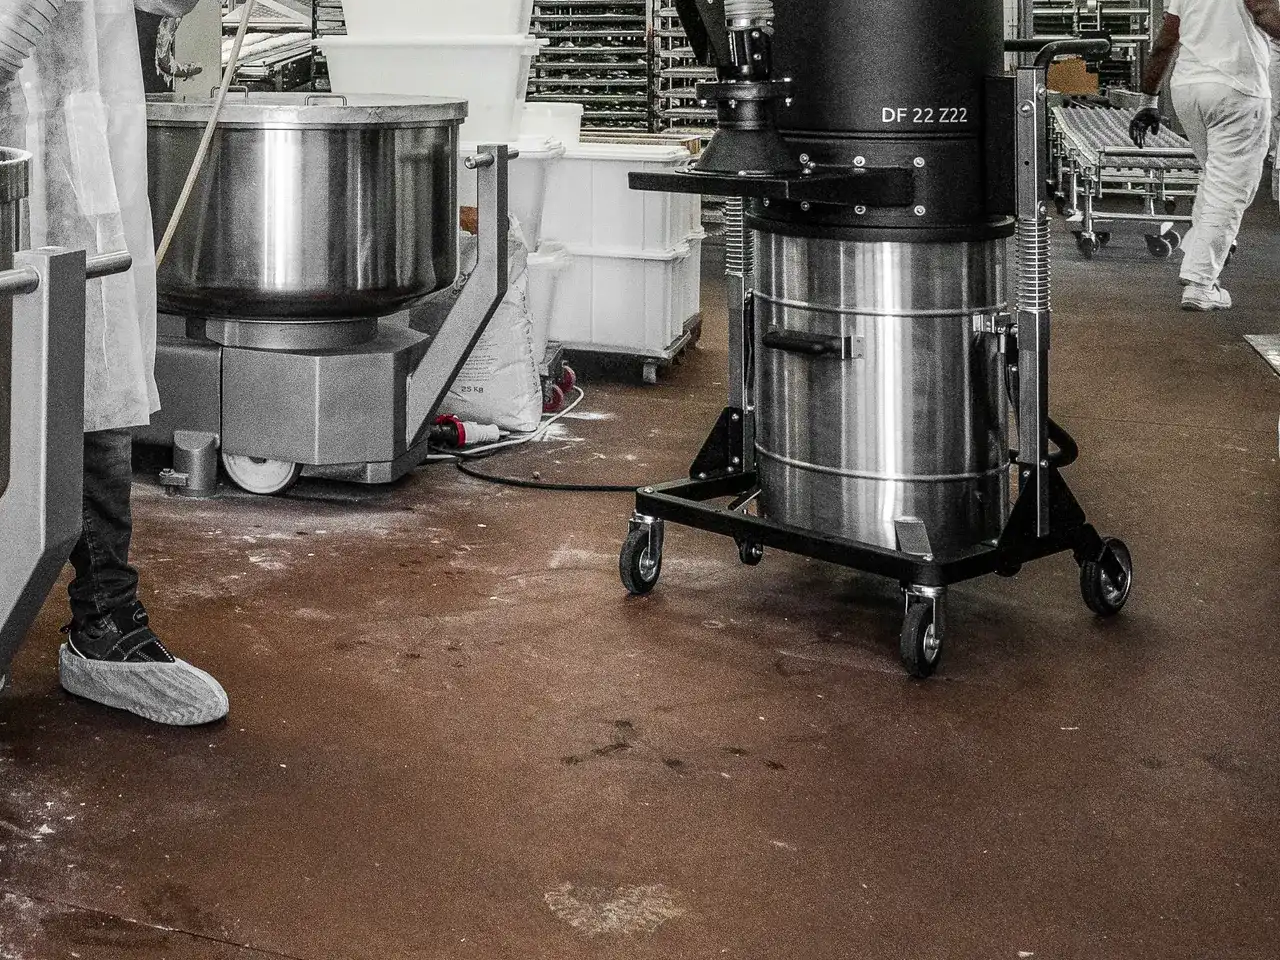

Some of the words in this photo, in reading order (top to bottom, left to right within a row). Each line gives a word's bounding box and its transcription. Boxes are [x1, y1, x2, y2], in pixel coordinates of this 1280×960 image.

[882, 107, 907, 122] DF
[913, 108, 934, 122] 22
[939, 108, 967, 122] Z22
